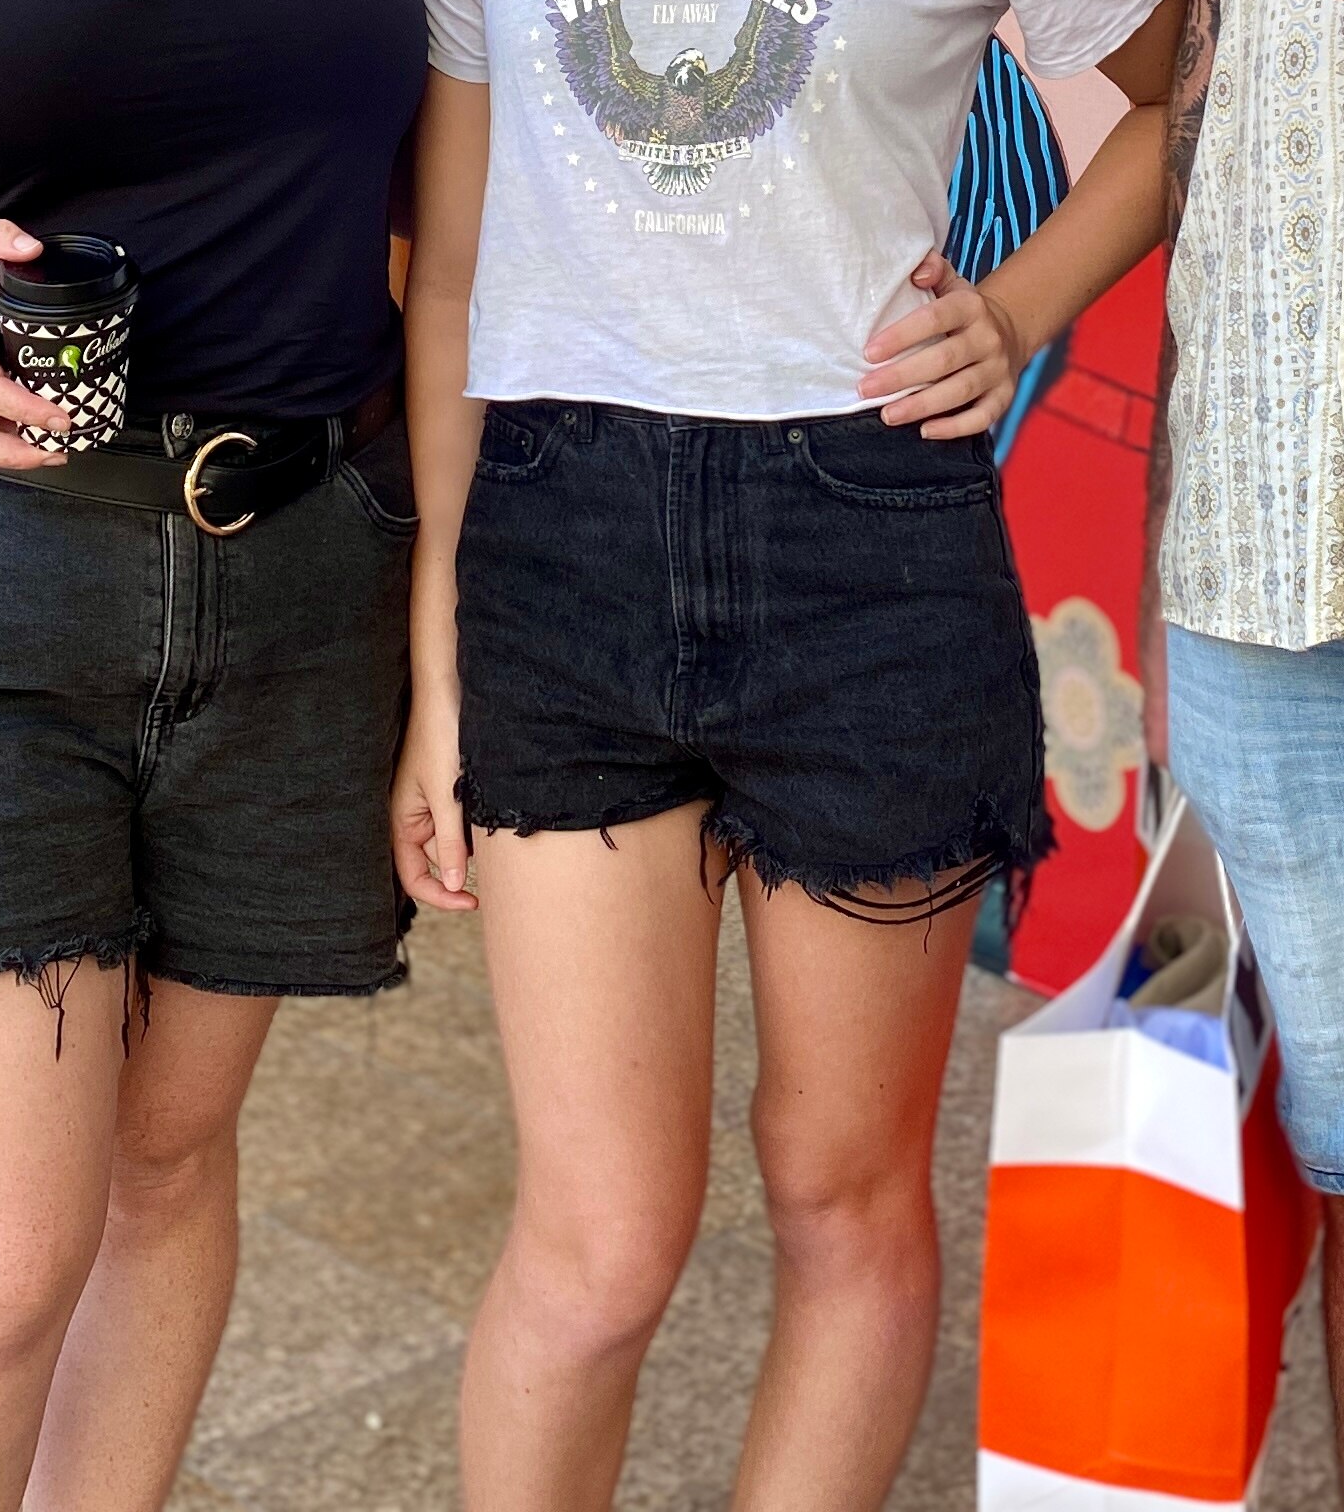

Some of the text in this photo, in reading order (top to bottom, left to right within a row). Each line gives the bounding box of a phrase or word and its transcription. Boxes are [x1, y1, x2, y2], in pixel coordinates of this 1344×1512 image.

[652, 3, 720, 24] FLY AWAY
[628, 138, 743, 163] UNITED STATES
[634, 209, 726, 235] CALIFORNIA
[18, 345, 55, 368] Coco
